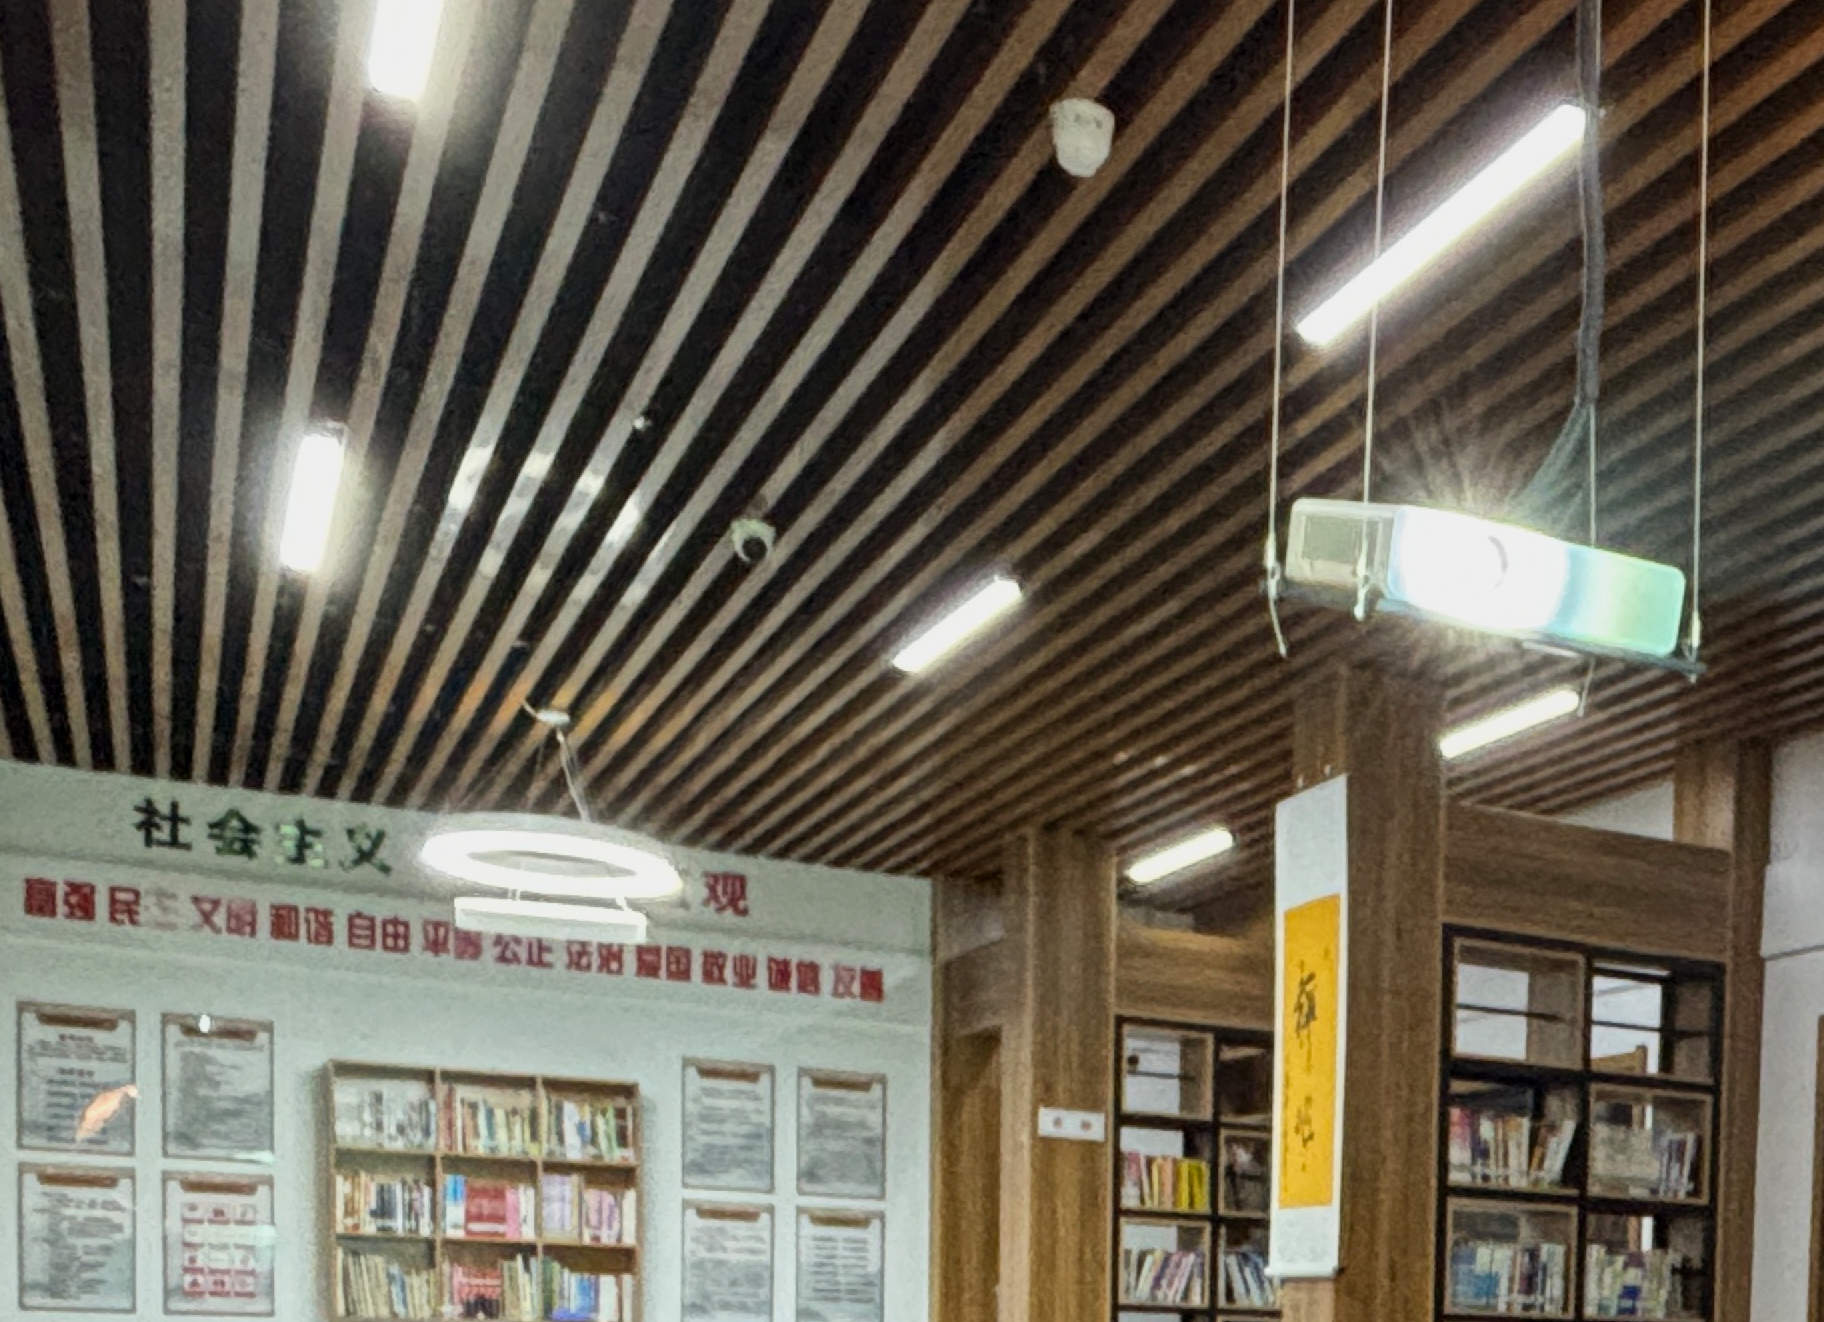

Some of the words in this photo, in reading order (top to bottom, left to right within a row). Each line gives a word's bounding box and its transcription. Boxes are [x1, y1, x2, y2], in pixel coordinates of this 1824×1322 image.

[133, 797, 393, 875] 社会主义
[703, 870, 750, 918] 观
[347, 911, 411, 953] 自由
